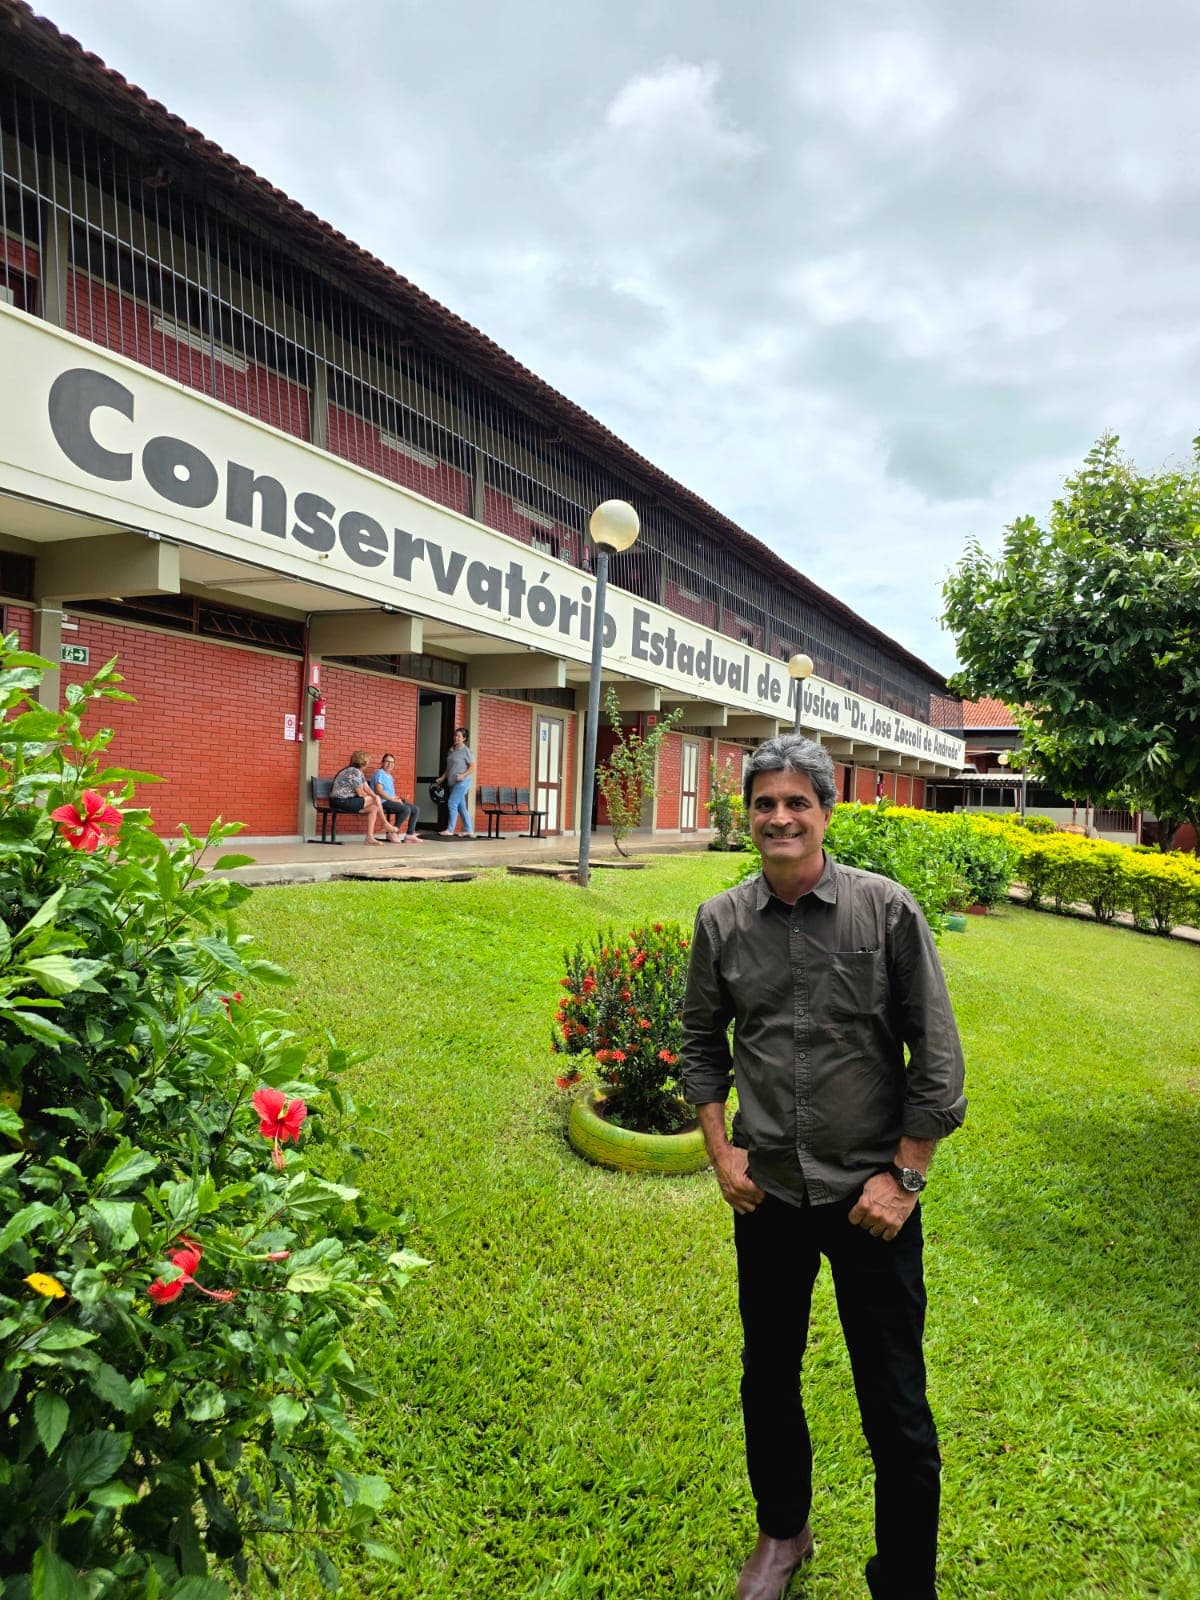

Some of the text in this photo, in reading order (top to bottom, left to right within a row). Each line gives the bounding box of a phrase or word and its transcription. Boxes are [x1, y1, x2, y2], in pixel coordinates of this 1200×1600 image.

[48, 368, 617, 649] Conservatório
[631, 607, 750, 694] Estadual
[757, 662, 782, 703] de
[870, 708, 892, 739] José
[923, 730, 932, 753] de
